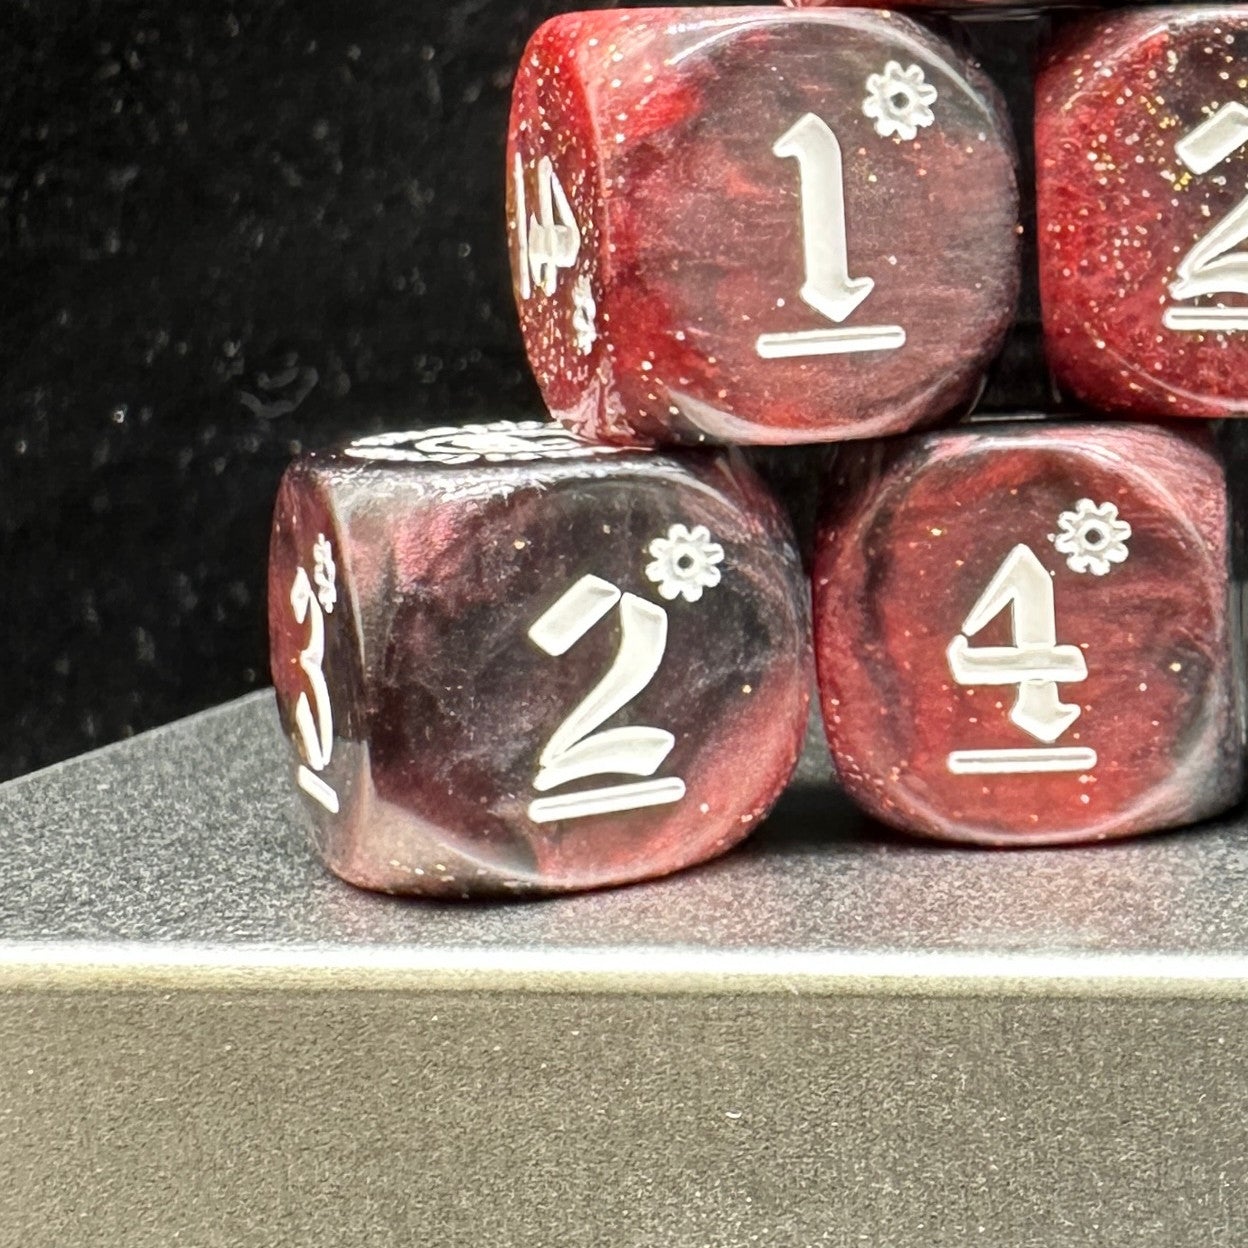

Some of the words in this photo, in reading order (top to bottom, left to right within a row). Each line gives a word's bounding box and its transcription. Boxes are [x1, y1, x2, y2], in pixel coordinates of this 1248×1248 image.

[773, 112, 875, 322] 1
[528, 574, 675, 791] 2
[947, 543, 1089, 743] 4
